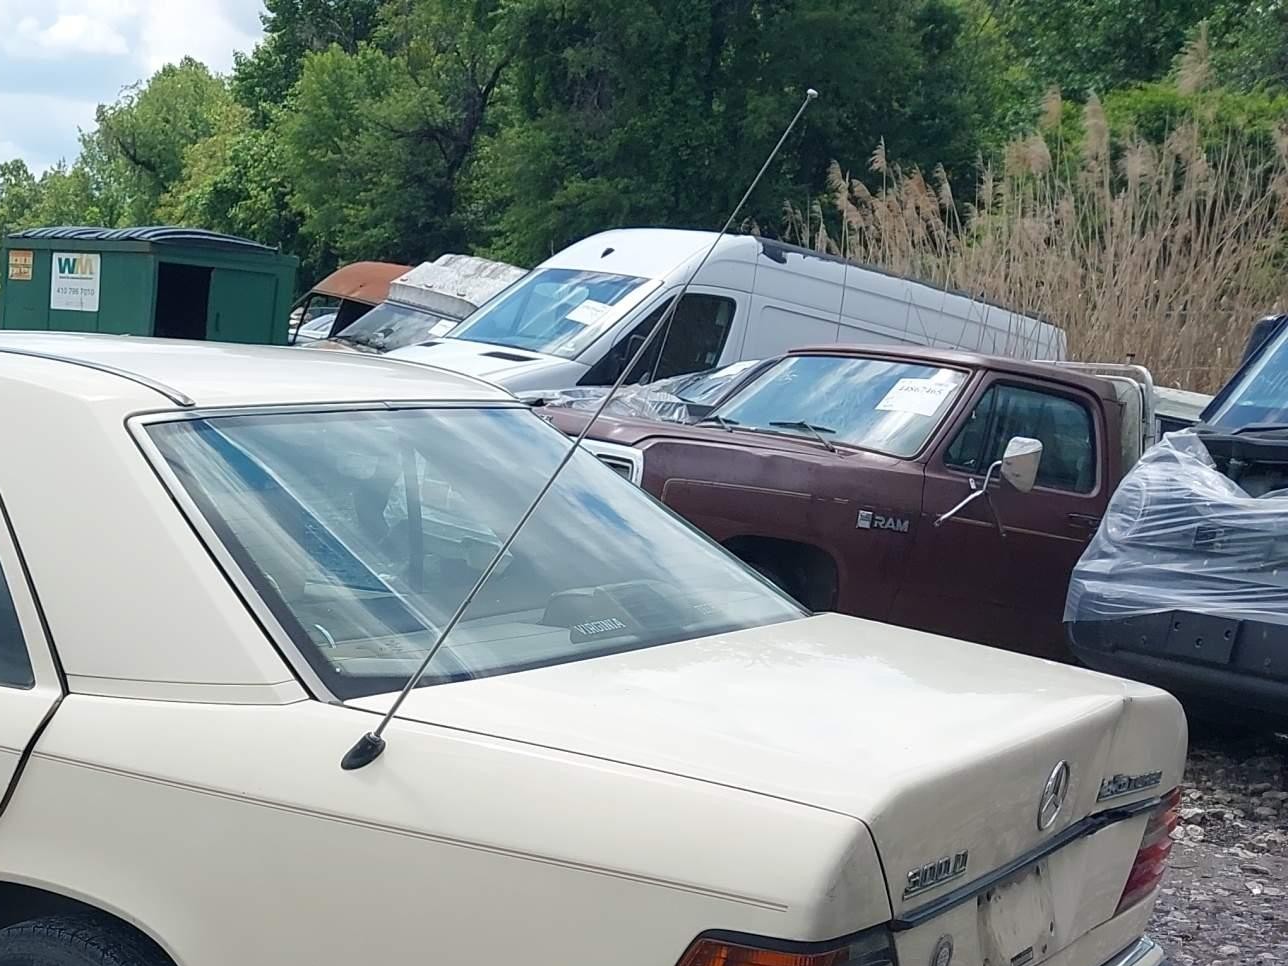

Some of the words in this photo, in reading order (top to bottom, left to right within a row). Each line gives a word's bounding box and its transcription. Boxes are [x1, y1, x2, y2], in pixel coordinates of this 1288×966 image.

[57, 257, 95, 275] WM
[873, 516, 909, 532] RAM
[573, 618, 627, 635] VIRGINIA
